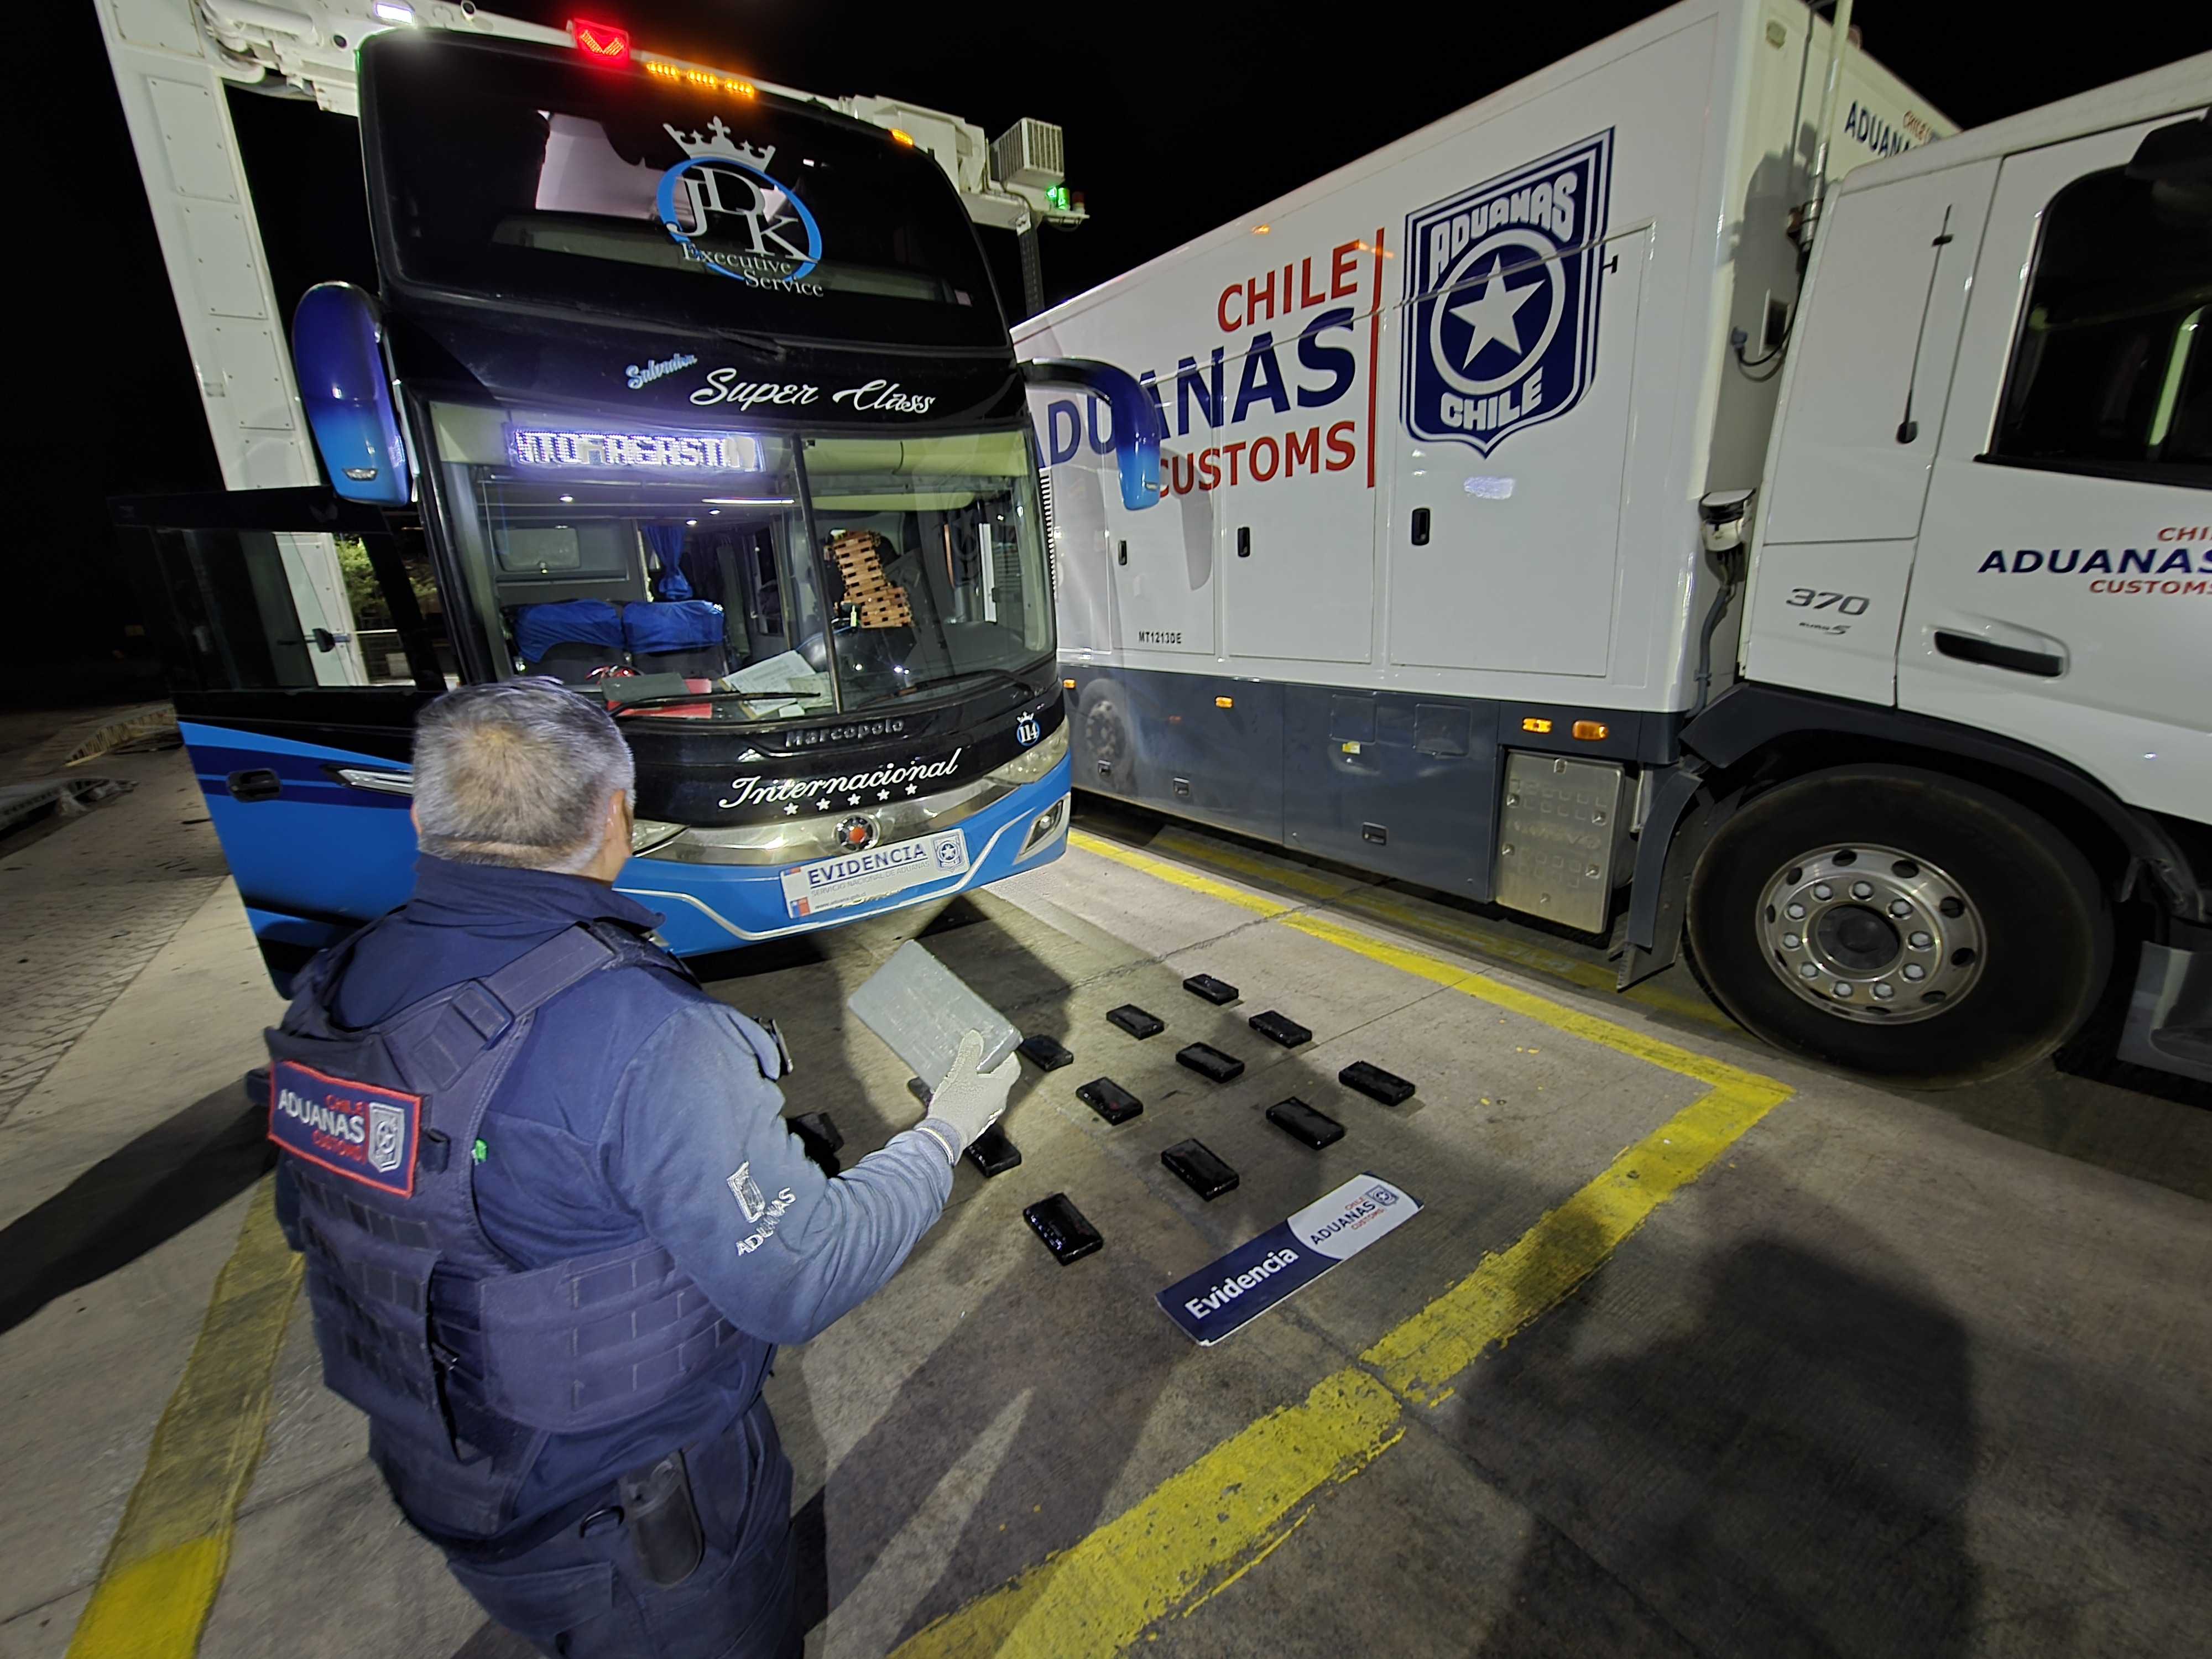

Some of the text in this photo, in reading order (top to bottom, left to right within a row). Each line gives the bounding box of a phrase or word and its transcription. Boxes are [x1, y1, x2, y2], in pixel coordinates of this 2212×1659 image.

[1844, 100, 1911, 158] ADUAN
[1428, 170, 1578, 294] ADUANAS
[681, 242, 791, 274] Executive
[744, 268, 824, 298] Service
[1218, 238, 1360, 332] CHILE
[690, 368, 936, 413] Super Class
[1441, 366, 1543, 431] CHILE
[2157, 526, 2212, 542] CHI
[1786, 588, 1870, 615] 370
[2090, 579, 2212, 594] CUSTOM
[785, 718, 904, 747] Marcopolo
[1019, 722, 1037, 743] 114
[719, 747, 962, 809] Internacional
[807, 843, 927, 885] EVIDENCIA
[896, 861, 930, 874] ADUANAS
[278, 1089, 366, 1143] ADUANAS
[1310, 1201, 1376, 1245] ADUANAS
[1185, 1248, 1300, 1319] Evidencia
